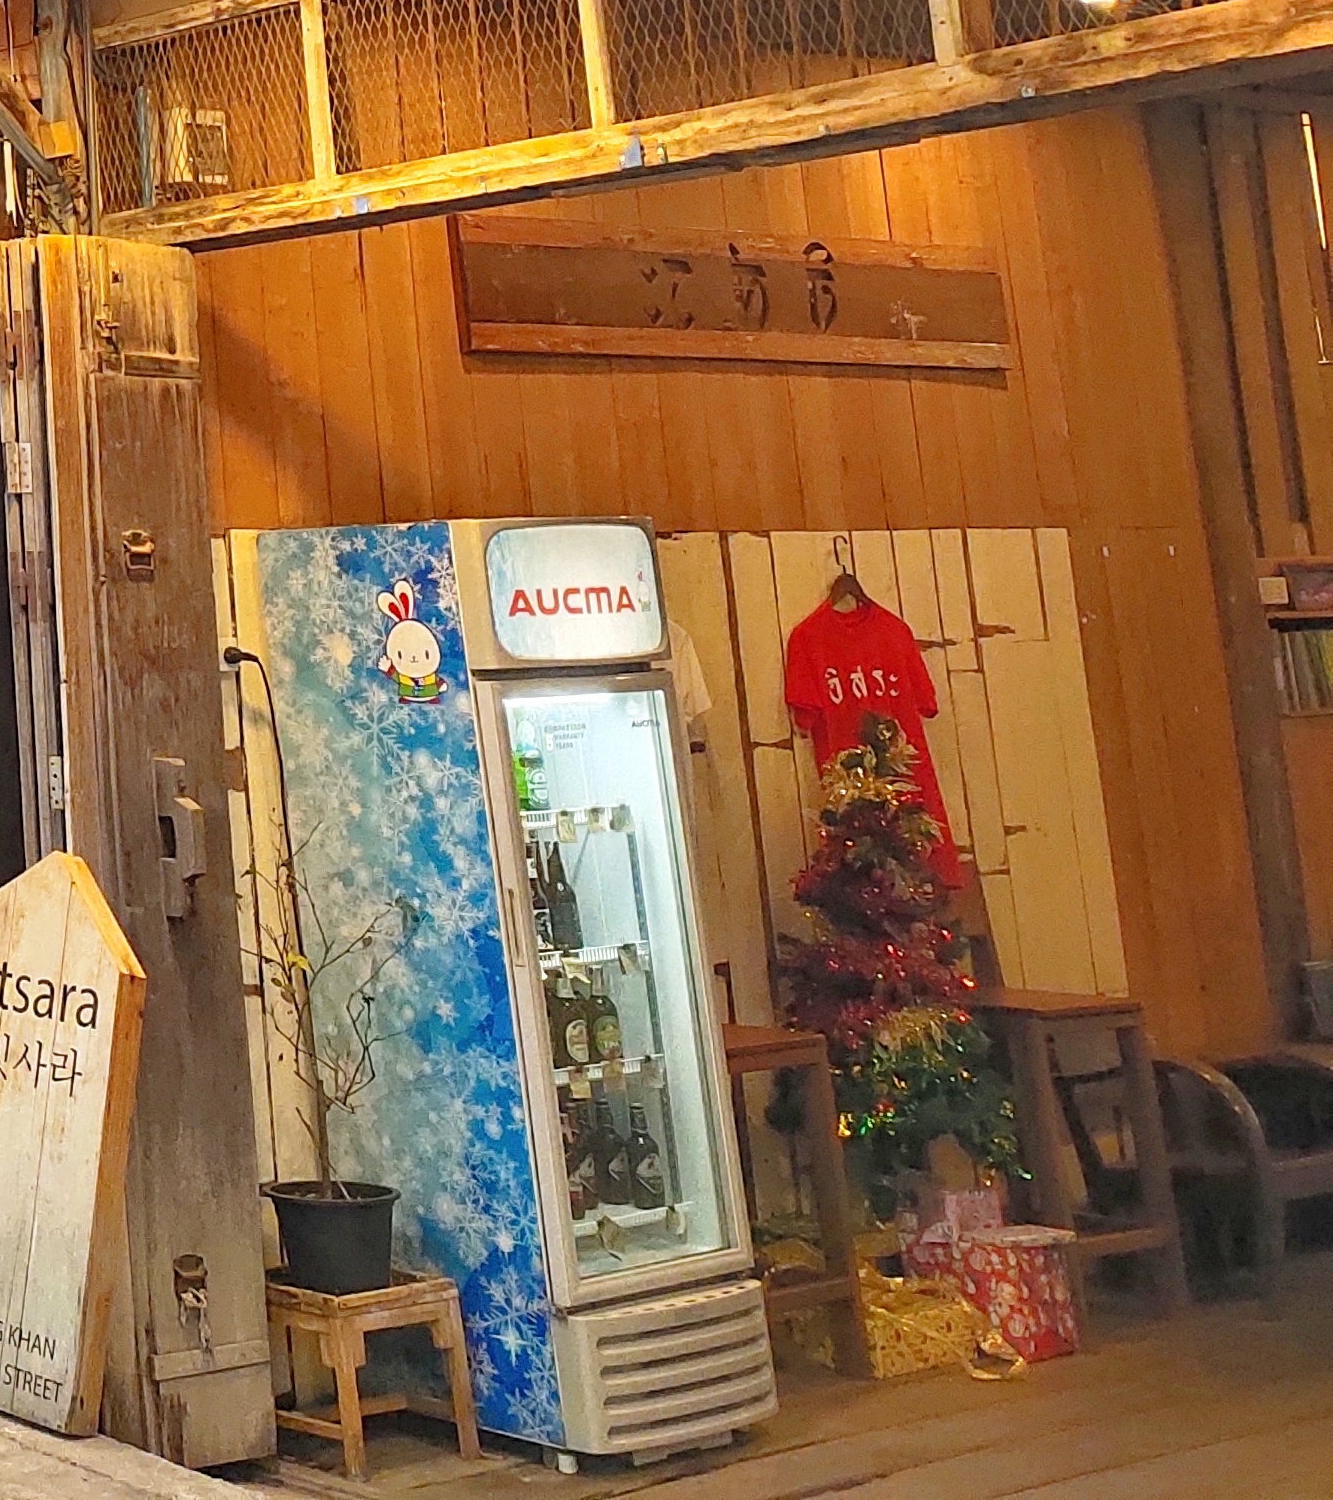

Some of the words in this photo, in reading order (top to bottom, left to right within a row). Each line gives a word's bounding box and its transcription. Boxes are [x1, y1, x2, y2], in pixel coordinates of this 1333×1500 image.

[508, 586, 636, 617] AUCMA
[824, 665, 899, 704] อิสระ
[8, 1326, 57, 1362] KHAN
[2, 1365, 63, 1404] STREET
